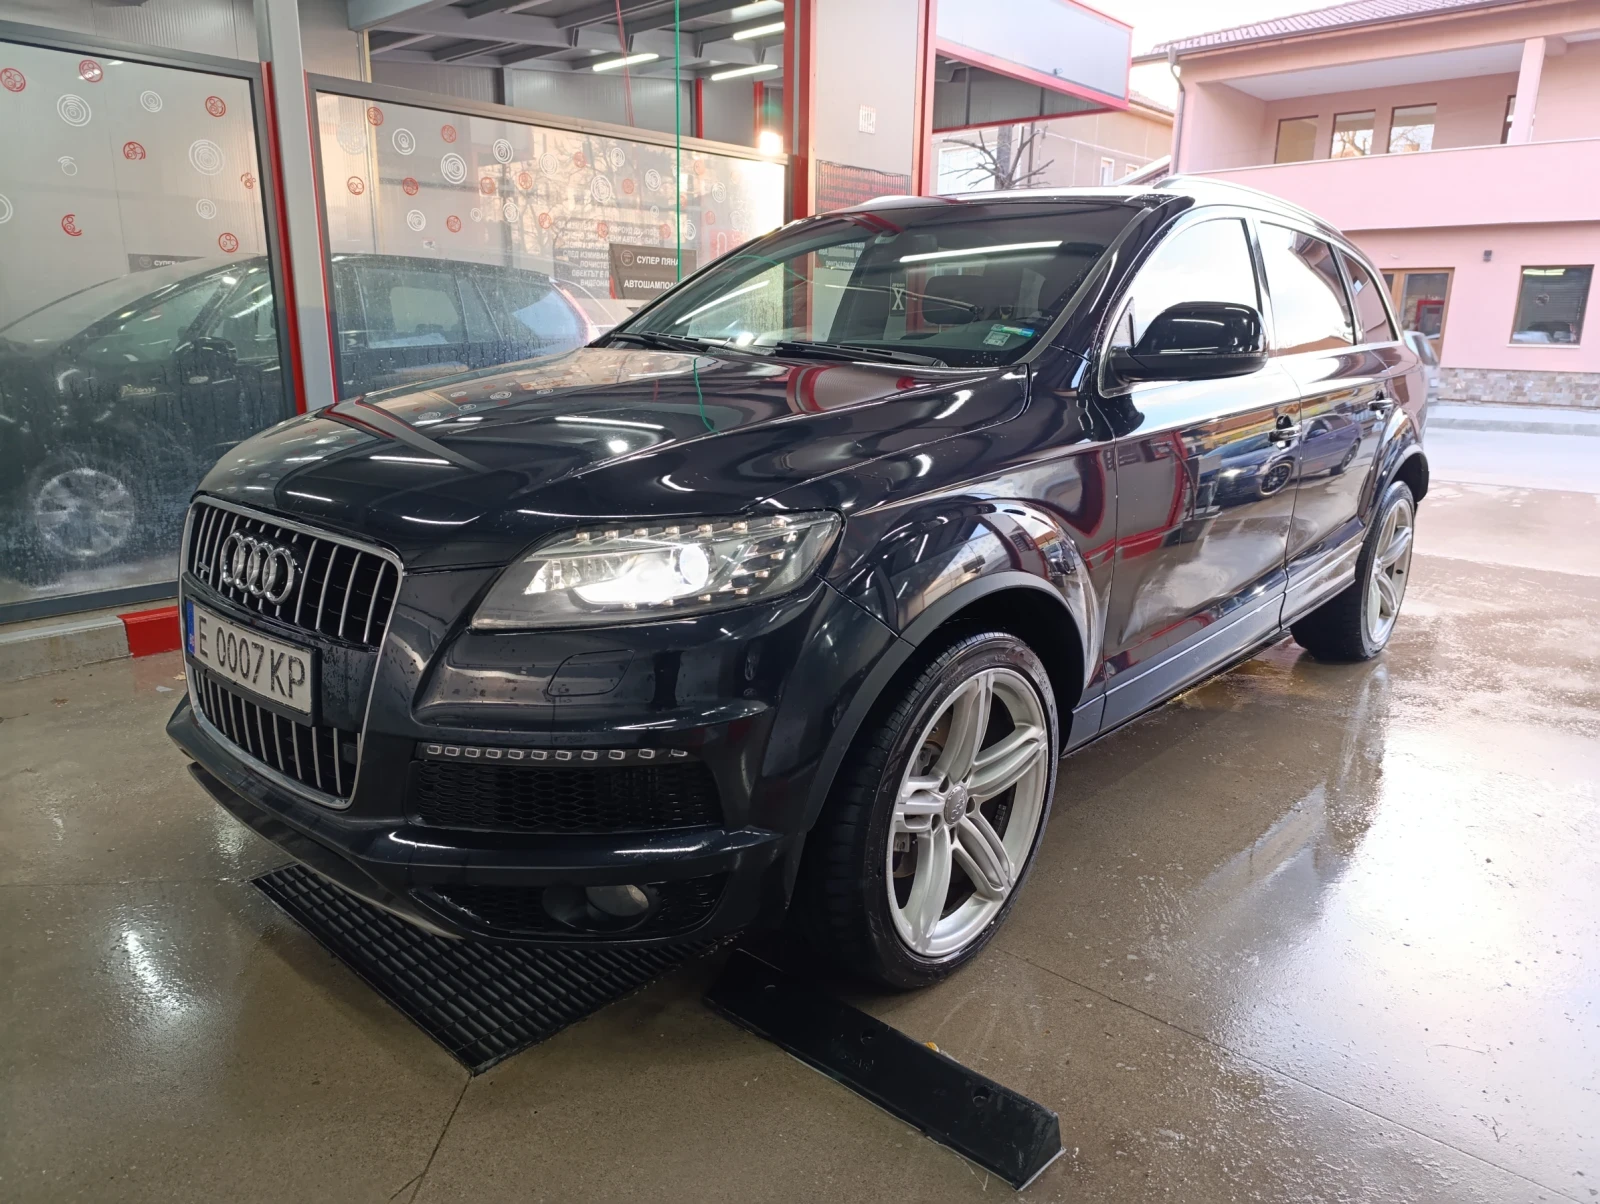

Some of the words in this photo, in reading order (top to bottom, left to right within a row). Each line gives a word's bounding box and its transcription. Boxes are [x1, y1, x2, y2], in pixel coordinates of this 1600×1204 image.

[636, 255, 660, 265] СУПЕР
[199, 615, 208, 659] E
[216, 626, 265, 684] 0007
[270, 648, 306, 699] KP
